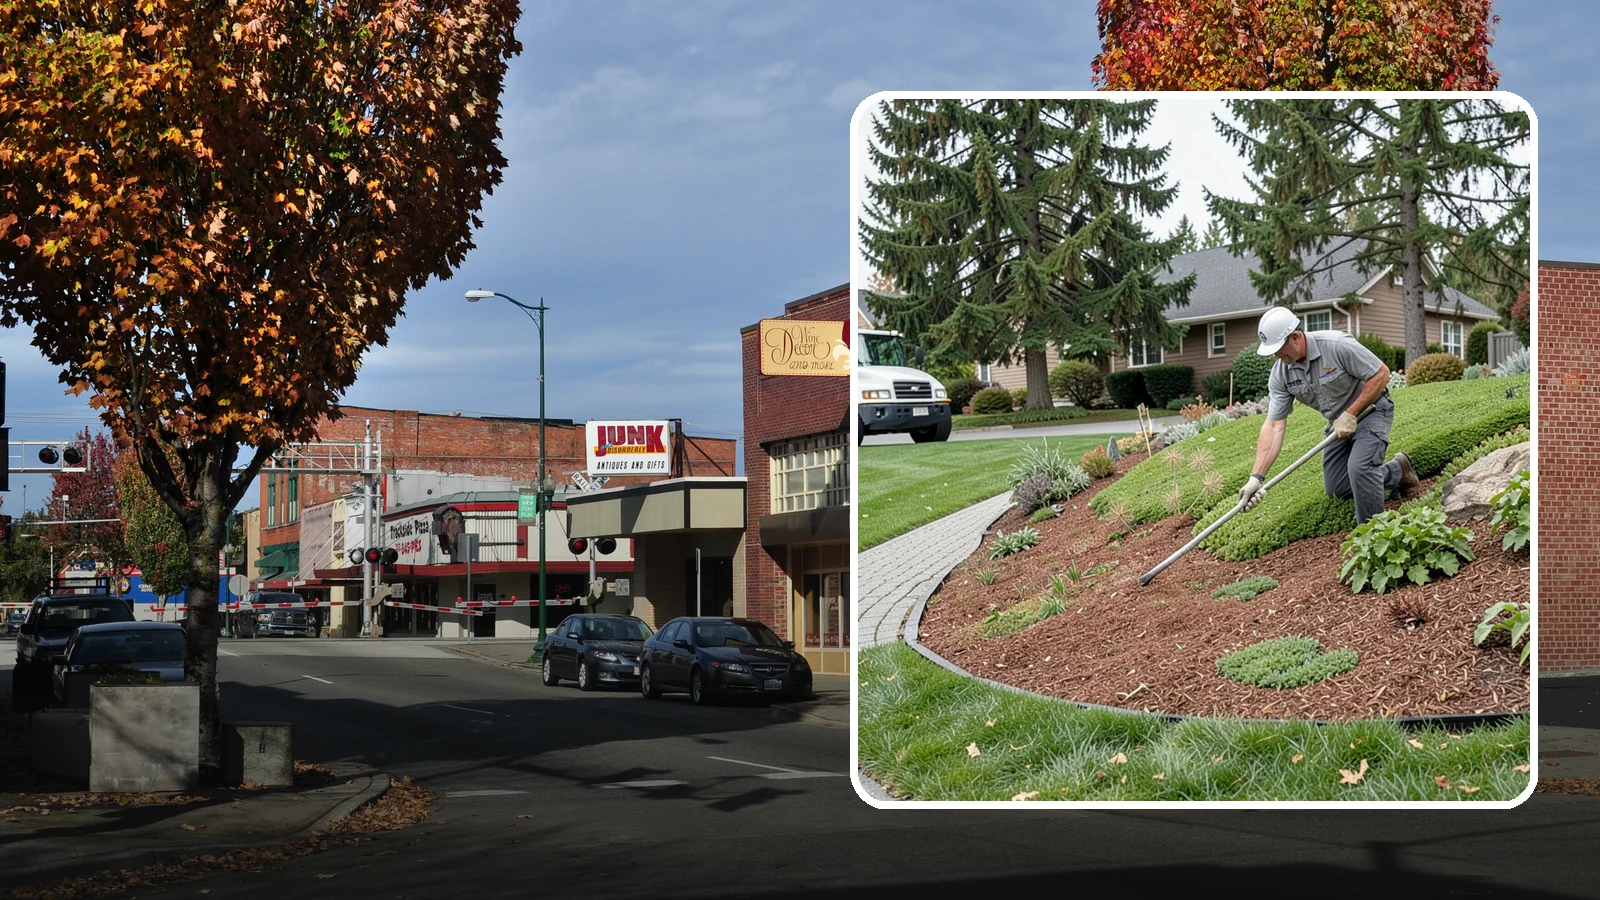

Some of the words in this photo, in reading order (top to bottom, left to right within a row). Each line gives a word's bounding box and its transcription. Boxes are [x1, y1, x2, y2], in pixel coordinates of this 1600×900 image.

[595, 425, 666, 457] JUNK
[607, 446, 645, 454] DISORDERLY
[597, 461, 628, 470] ANTIQUES
[631, 461, 644, 470] AND
[647, 461, 666, 469] GIFTS
[353, 499, 364, 511] CRO
[390, 520, 413, 540] Trackside
[414, 519, 429, 535] Pizza
